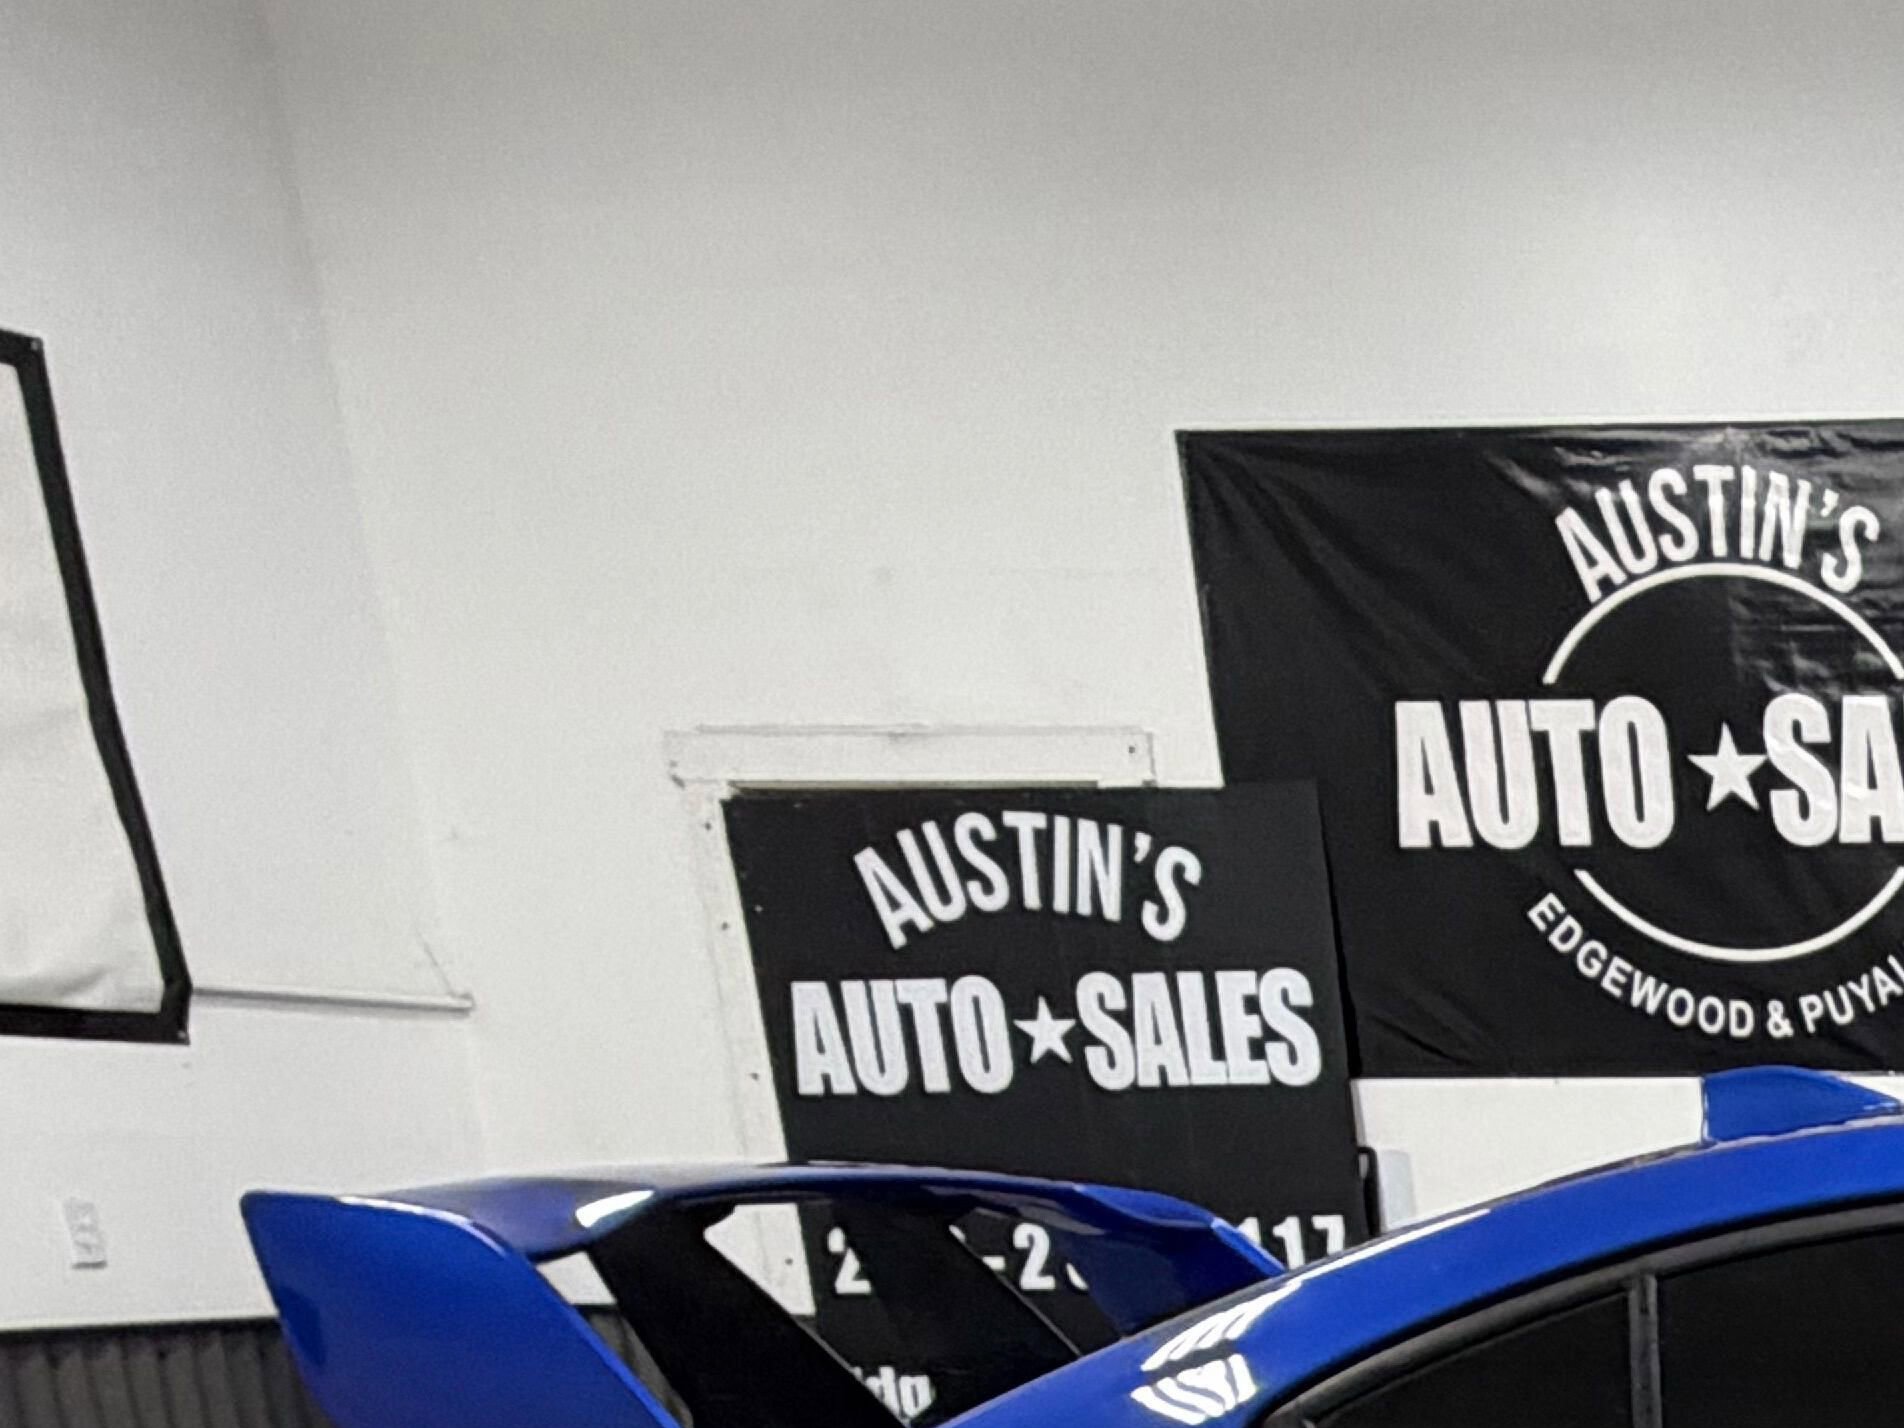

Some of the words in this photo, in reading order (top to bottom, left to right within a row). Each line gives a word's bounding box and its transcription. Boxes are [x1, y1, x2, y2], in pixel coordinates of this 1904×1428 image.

[1553, 460, 1882, 604] AUSTIN'S
[1393, 694, 1676, 851] AUTO
[853, 809, 1203, 950] AUSTIN'S
[789, 974, 1015, 1097] AUTO
[1078, 966, 1323, 1092] SALES
[1526, 891, 1756, 1038] EDGEWOOD
[1765, 999, 1795, 1039] &
